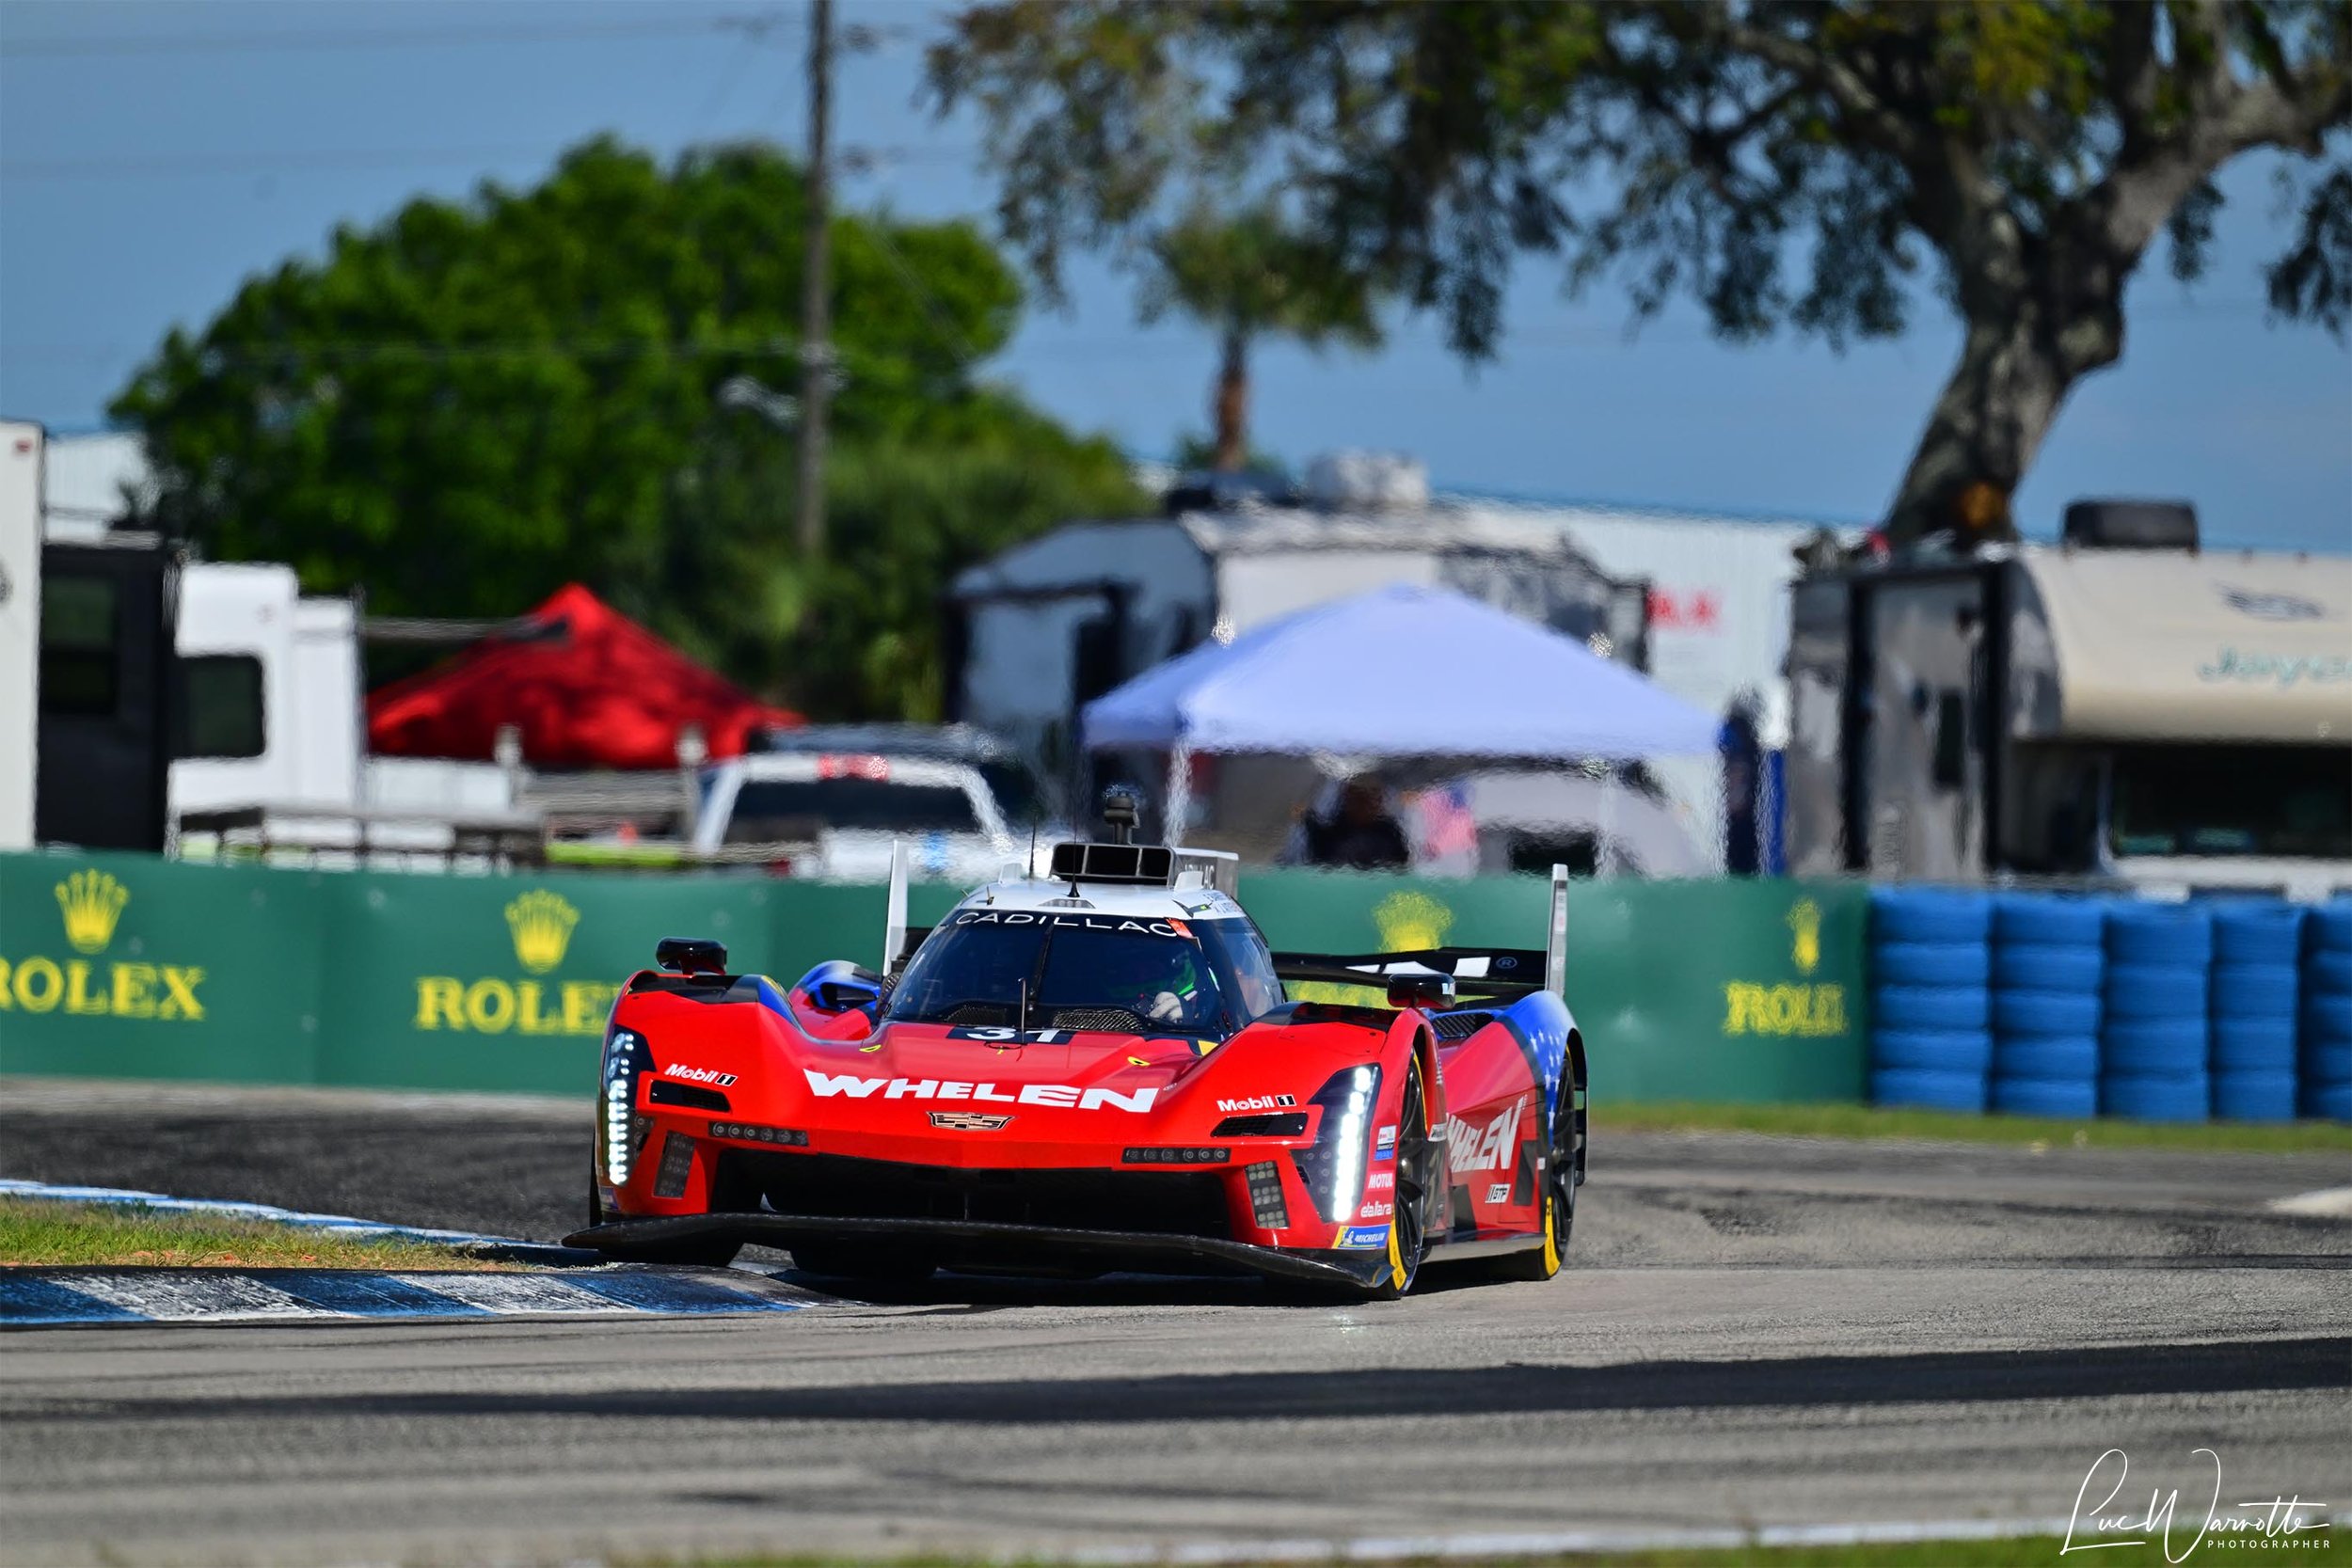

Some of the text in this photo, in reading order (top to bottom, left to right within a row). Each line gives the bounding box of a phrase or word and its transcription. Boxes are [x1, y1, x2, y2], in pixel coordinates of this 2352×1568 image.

[956, 912, 1178, 938] CADILLAC
[0, 955, 206, 1021] OLEX
[414, 976, 623, 1036] ROLE
[966, 1025, 1061, 1043] 31
[664, 1063, 719, 1084] Mobil
[803, 1069, 1159, 1113] WHELEN
[1216, 1095, 1275, 1112] Mobil
[1368, 1172, 1393, 1189] MOTUL
[1355, 1231, 1386, 1243] MICHELIN
